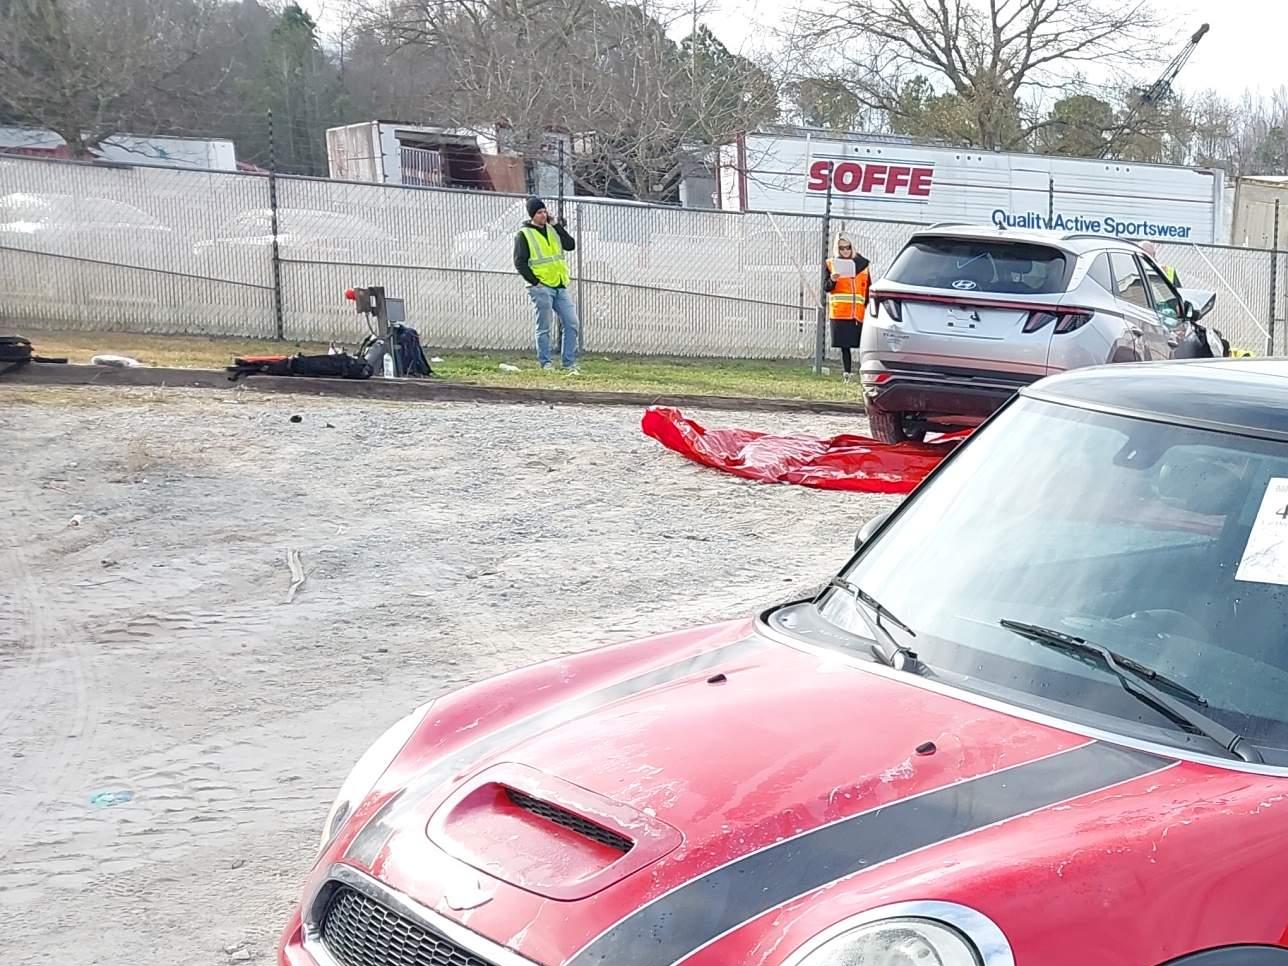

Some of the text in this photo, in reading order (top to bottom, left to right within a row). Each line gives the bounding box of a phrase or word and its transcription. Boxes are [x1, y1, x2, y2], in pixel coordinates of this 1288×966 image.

[807, 160, 935, 197] SOFFE
[991, 209, 1192, 238] Quality Active Sportswear
